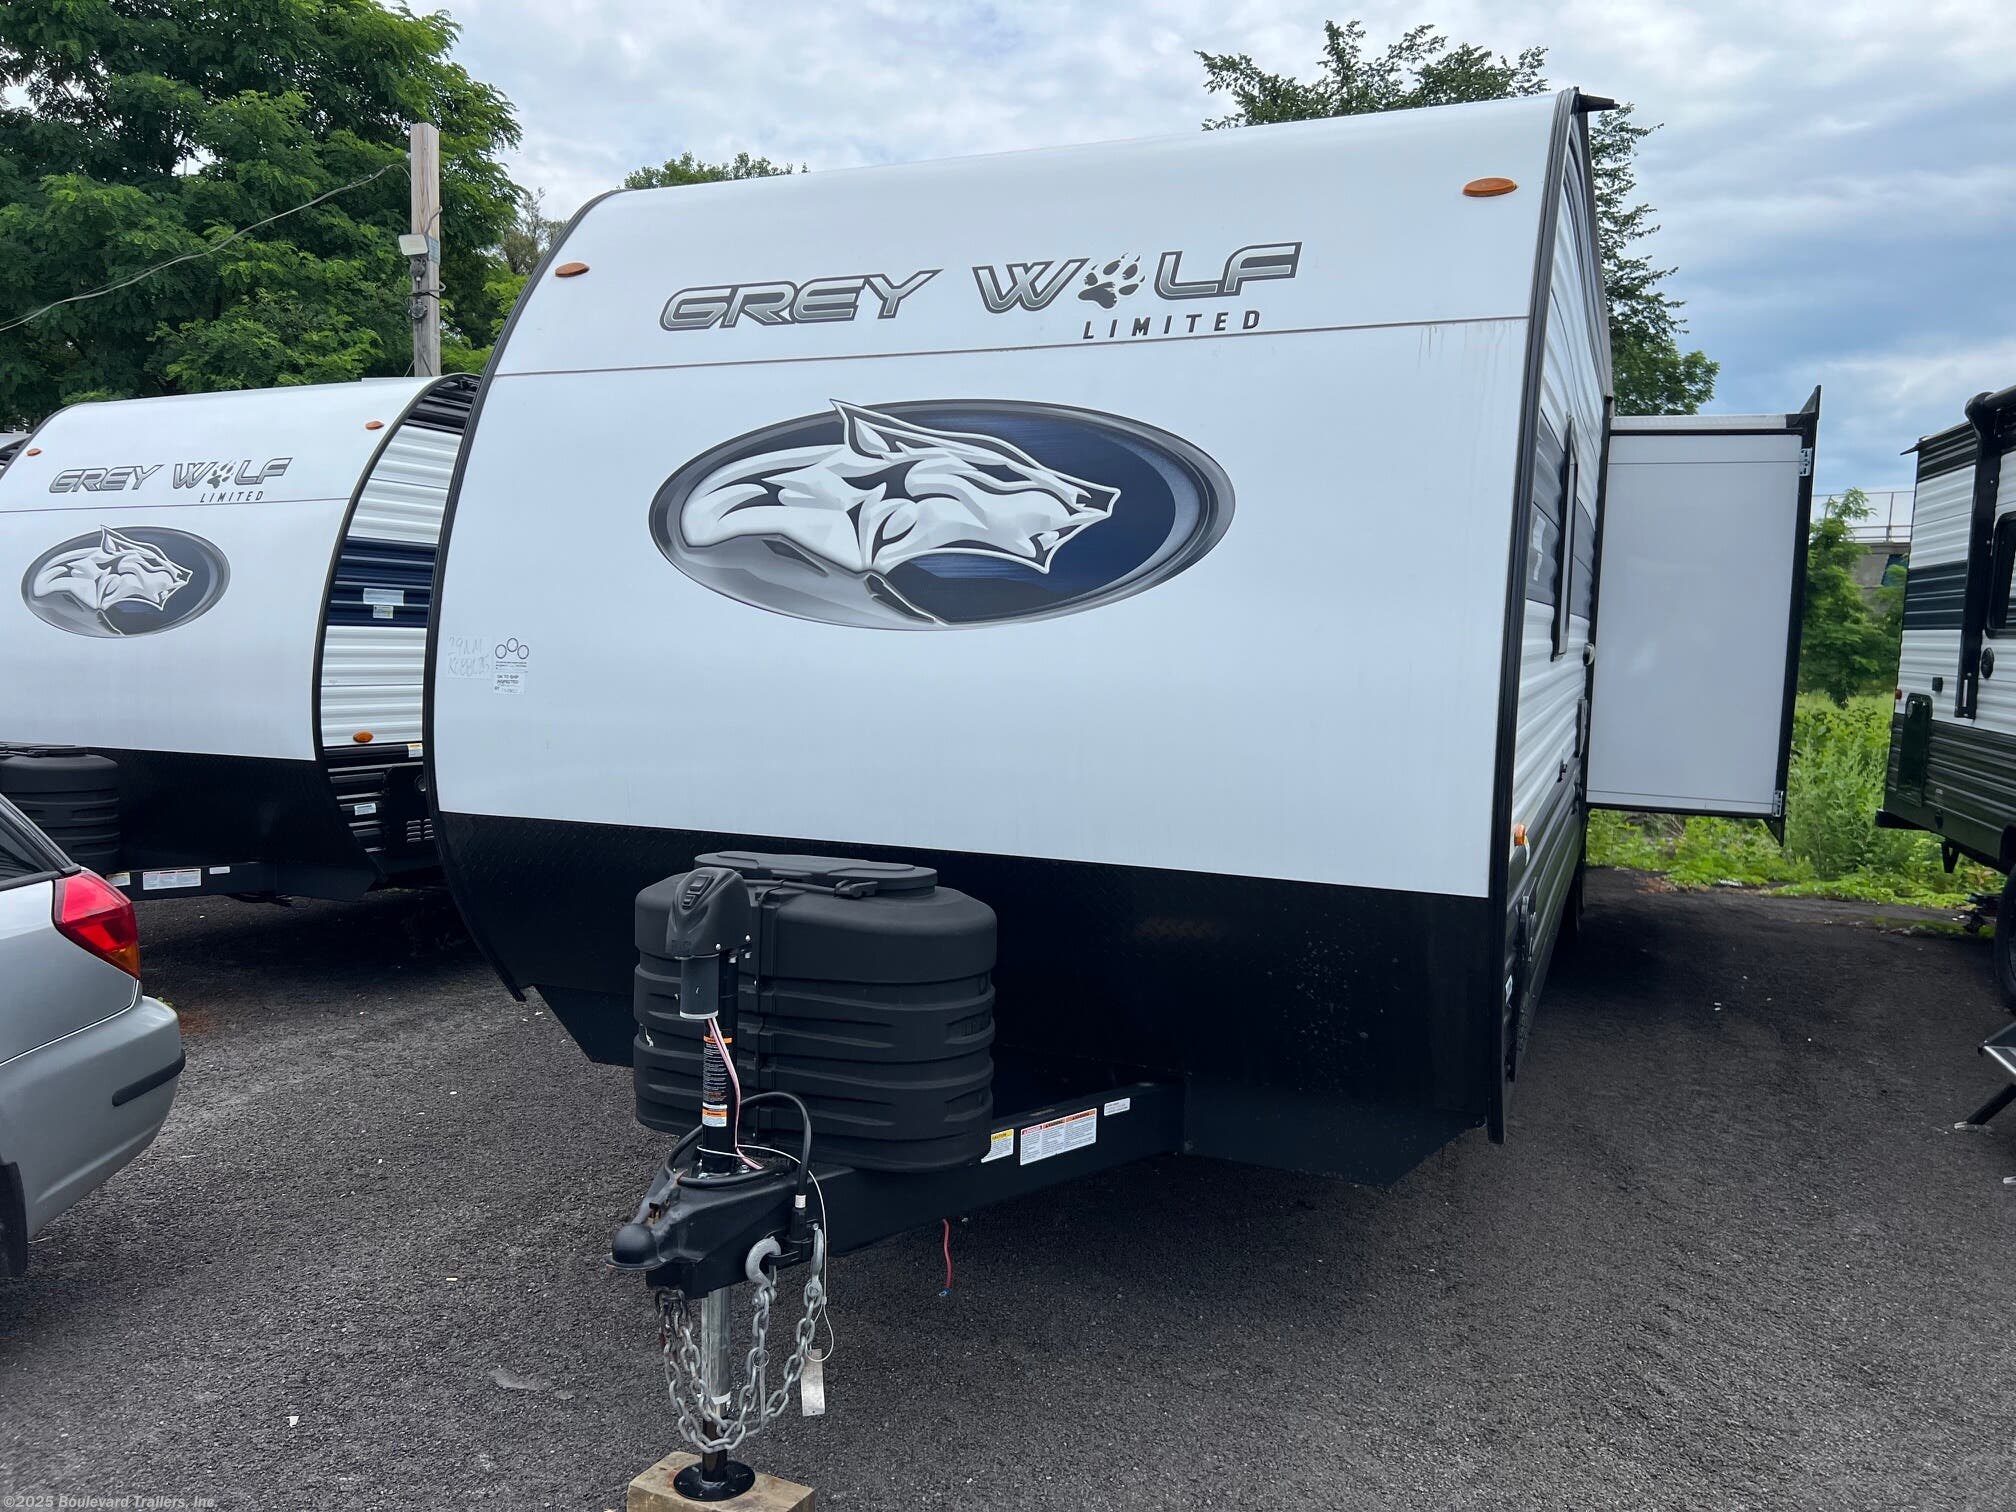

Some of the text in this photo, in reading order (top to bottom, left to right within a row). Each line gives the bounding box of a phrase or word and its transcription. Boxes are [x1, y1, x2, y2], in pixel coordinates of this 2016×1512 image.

[660, 268, 944, 331] GREY
[1082, 309, 1261, 339] LIMITED
[49, 464, 165, 493] GREY
[200, 491, 264, 503] LIMITED
